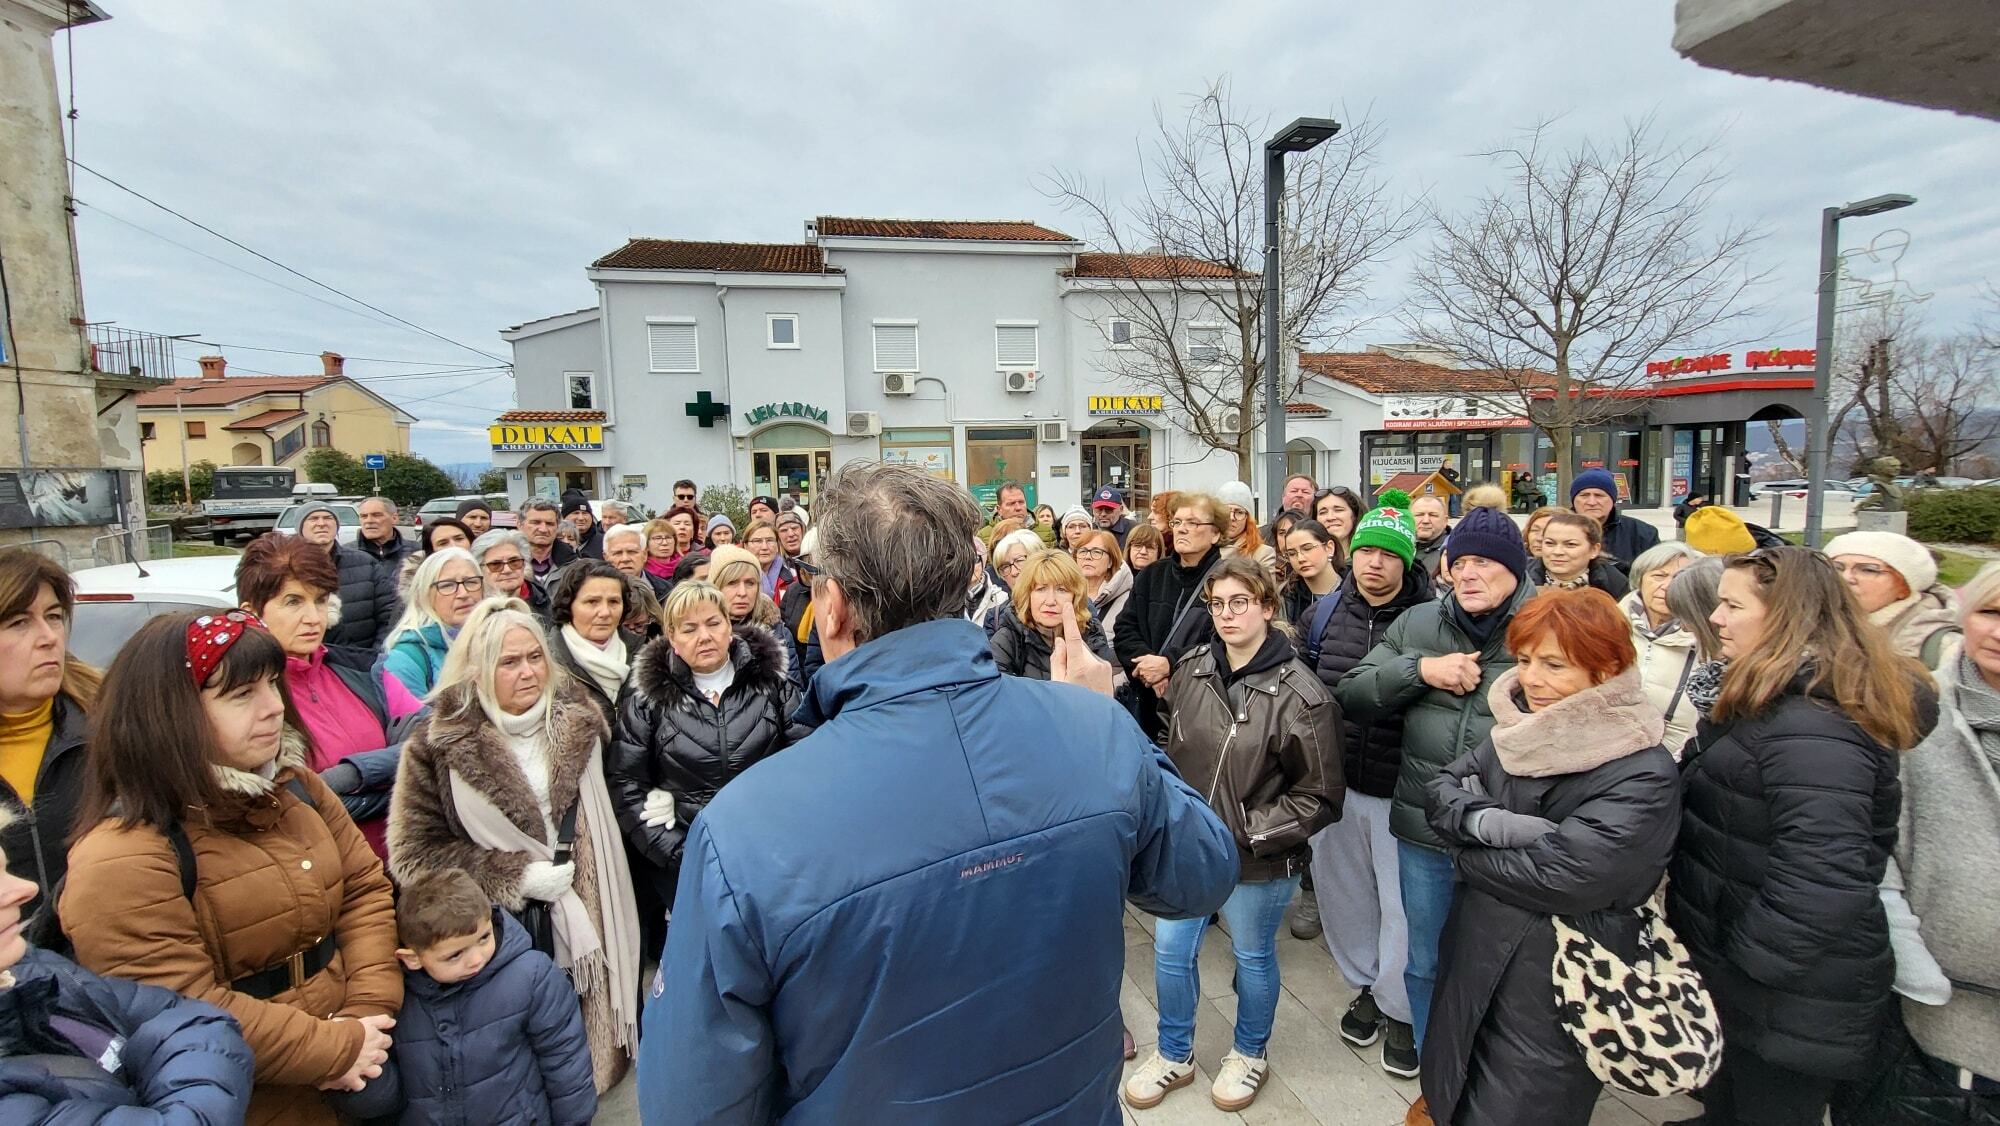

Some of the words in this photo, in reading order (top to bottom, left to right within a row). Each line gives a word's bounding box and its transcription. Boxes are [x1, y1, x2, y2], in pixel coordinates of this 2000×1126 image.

[1096, 397, 1158, 410] DUKAT
[744, 402, 828, 426] LJEKARNA
[501, 426, 593, 444] DUKAT
[1420, 457, 1442, 465] SERVIS
[960, 853, 1024, 878] MAMMUT
